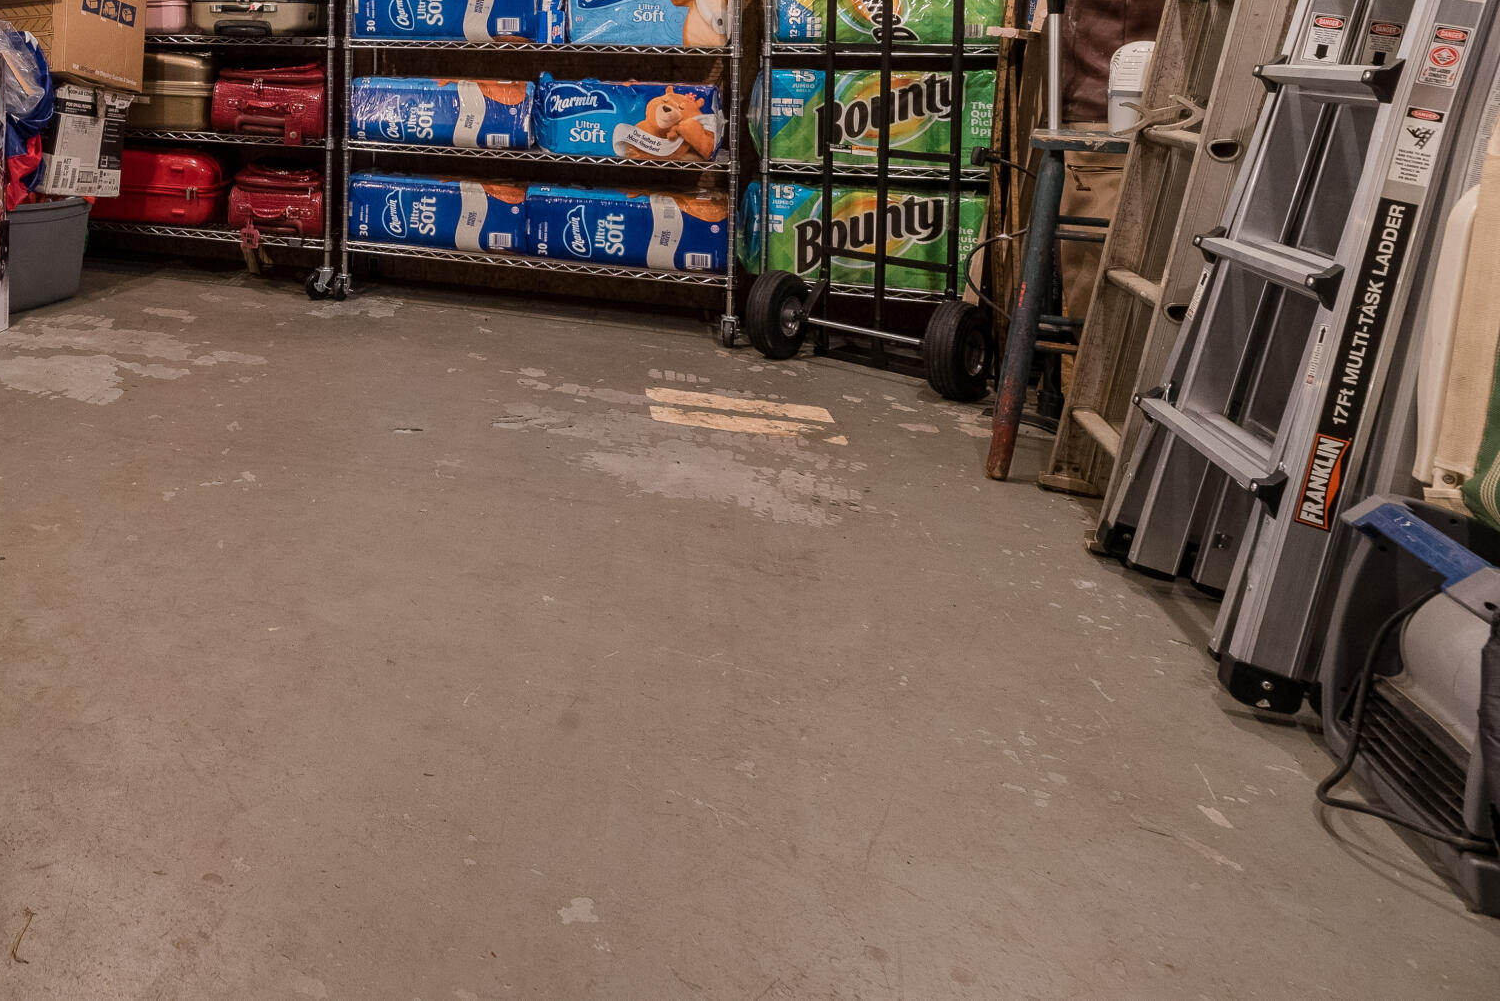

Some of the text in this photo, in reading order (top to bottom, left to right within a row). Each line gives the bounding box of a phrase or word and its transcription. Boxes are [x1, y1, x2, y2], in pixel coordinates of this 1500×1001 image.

[632, 8, 665, 24] Soft
[636, 2, 661, 12] Ultra
[366, 19, 376, 32] 30
[1318, 17, 1342, 27] DANGER
[1373, 23, 1399, 34] DANGER
[1439, 29, 1467, 40] DANGER
[547, 92, 599, 112] Charmin
[970, 101, 993, 111] The
[406, 105, 418, 134] Ultra
[416, 100, 434, 140] Soft
[574, 119, 601, 130] Ultra
[569, 127, 607, 144] Soft
[770, 184, 795, 199] 15
[386, 197, 401, 235] Charmin
[409, 202, 420, 228] Ultra
[418, 196, 437, 236] Soft
[359, 223, 369, 237] 30
[570, 215, 585, 254] Charmin
[594, 218, 606, 247] Ultra
[605, 212, 625, 256] Soft
[794, 194, 948, 276] Bounty
[1373, 204, 1406, 276] LADDER
[537, 242, 548, 256] 30
[1344, 281, 1386, 387] MULTI-TASK
[1299, 436, 1346, 527] FRANKLIN
